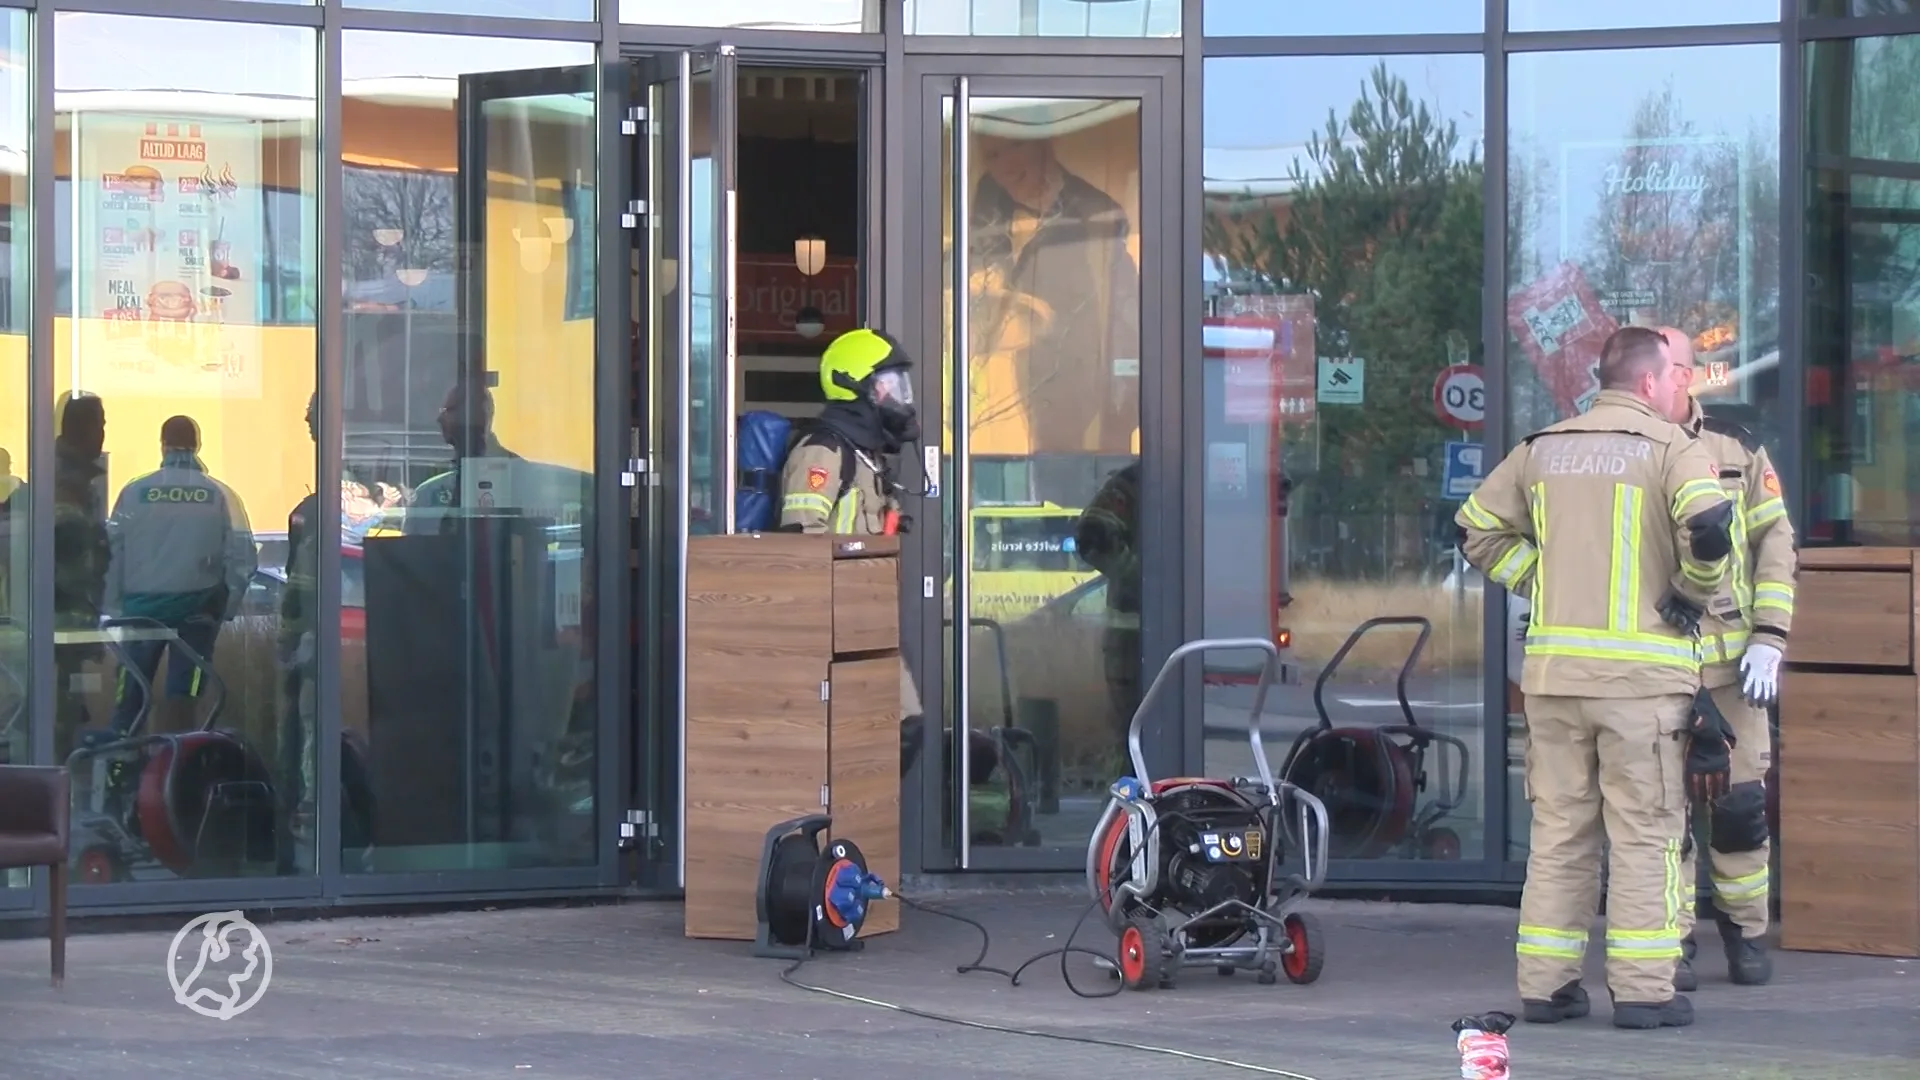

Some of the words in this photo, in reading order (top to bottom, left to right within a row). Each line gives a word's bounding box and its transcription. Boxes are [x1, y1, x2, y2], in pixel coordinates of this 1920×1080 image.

[142, 142, 175, 158] ALTIJD
[177, 144, 204, 159] LAAG
[1605, 161, 1710, 205] Holiday
[108, 279, 136, 295] MEAL
[116, 295, 143, 310] DEAL
